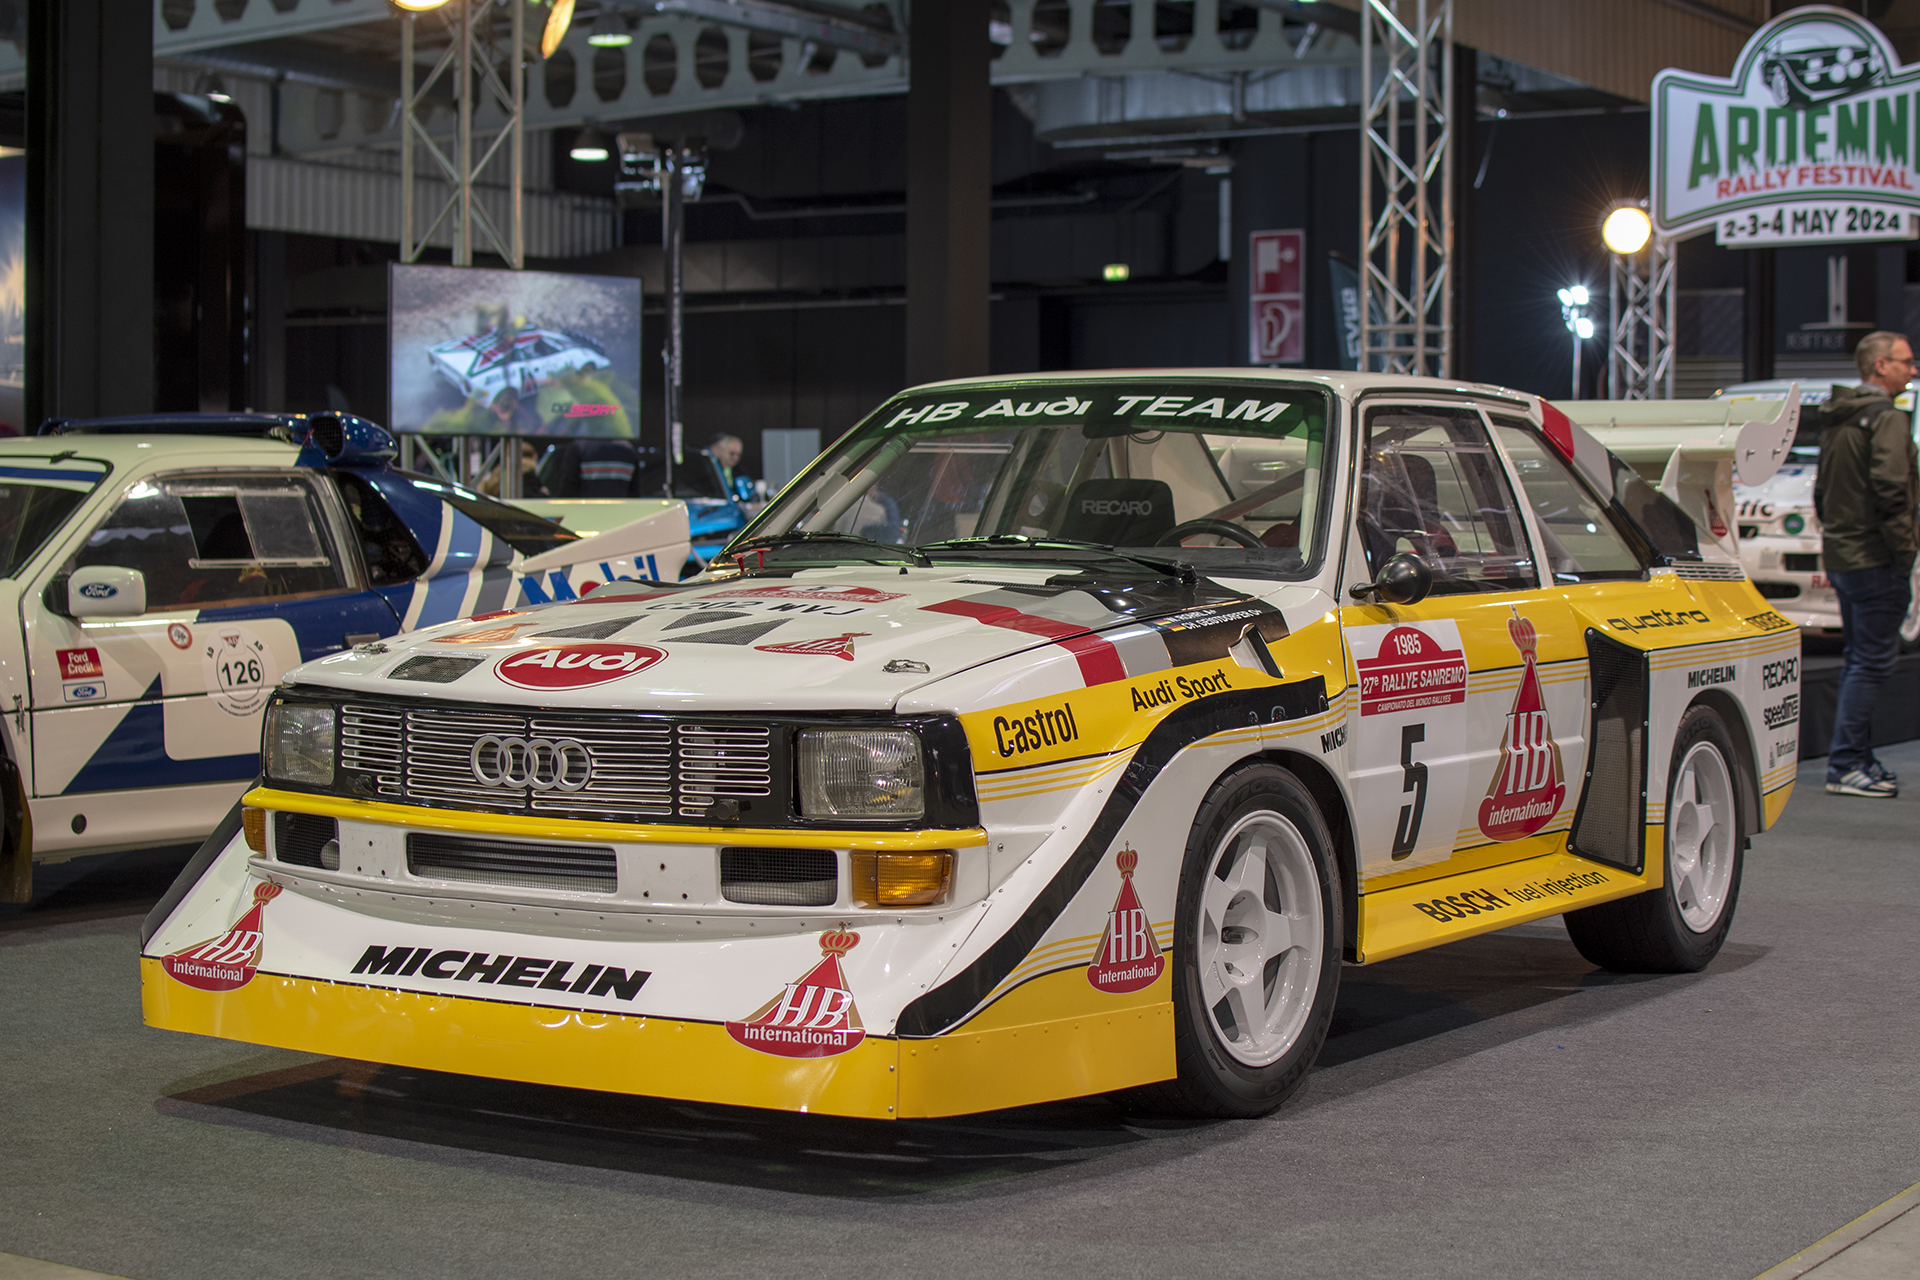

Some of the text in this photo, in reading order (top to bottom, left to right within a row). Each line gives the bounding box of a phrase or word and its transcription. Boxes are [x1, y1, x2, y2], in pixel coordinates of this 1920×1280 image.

[1687, 92, 1920, 190] ARDENN
[1716, 165, 1914, 200] RALLY FESTIVAL
[1724, 207, 1900, 238] 2-3-4 MAY 2024
[884, 395, 1291, 429] HB Audi TEAM
[1082, 499, 1153, 516] RECARO
[85, 584, 110, 598] Ford
[1607, 609, 1711, 634] quattro
[67, 651, 89, 664] Ford
[1394, 633, 1422, 655] 1985
[67, 662, 95, 675] Credit
[221, 659, 261, 686] 126
[505, 650, 653, 672] Audi
[1763, 656, 1799, 690] RECARO
[1130, 669, 1232, 713] Audi Sport
[1381, 671, 1418, 692] RALLYE
[1419, 665, 1466, 688] SANREMO
[1687, 665, 1736, 689] MICHELIN
[1377, 700, 1407, 712] CAMPIONATO
[1406, 699, 1415, 709] DEL
[1416, 696, 1432, 707] MONDO
[993, 703, 1079, 758] Castrol
[1320, 726, 1348, 754] MICH
[1504, 709, 1552, 796] HB
[1391, 723, 1428, 862] 5
[1488, 794, 1556, 826] international
[1412, 869, 1610, 923] BOSCH fuel injection
[191, 930, 265, 965] HB
[1108, 907, 1147, 964] HB
[173, 958, 244, 982] international
[349, 945, 653, 1001] MICHELIN
[1098, 962, 1157, 985] international
[766, 983, 855, 1029] HB
[744, 1023, 848, 1046] international
